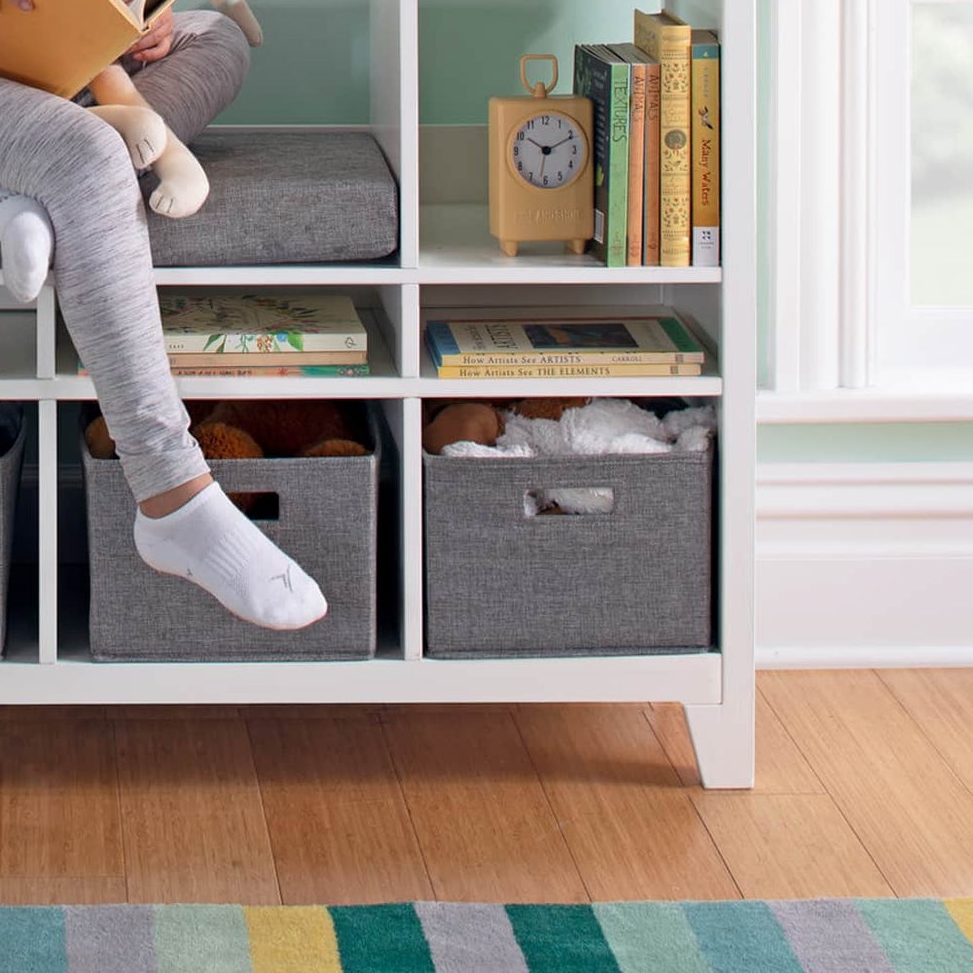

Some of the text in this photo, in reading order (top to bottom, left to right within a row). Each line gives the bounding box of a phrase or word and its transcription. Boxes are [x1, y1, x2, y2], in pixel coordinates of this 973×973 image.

[633, 76, 644, 123] ANIMALS
[648, 75, 660, 121] ANIMALS
[612, 78, 628, 143] TEXTURES
[527, 120, 534, 130] 11
[542, 115, 550, 125] 12
[558, 119, 562, 129] 1
[517, 131, 525, 141] 10
[568, 130, 573, 140] 2
[514, 146, 519, 156] 9
[572, 145, 577, 155] 3
[518, 161, 523, 171] 8
[568, 160, 573, 169] 4
[529, 172, 533, 182] 7
[558, 171, 563, 181] 5
[699, 139, 712, 206] Many Waters
[543, 175, 548, 186] 6
[463, 355, 581, 365] How Artists See ARTISTS
[459, 366, 611, 377] How Artists See THE ELEMENTS
